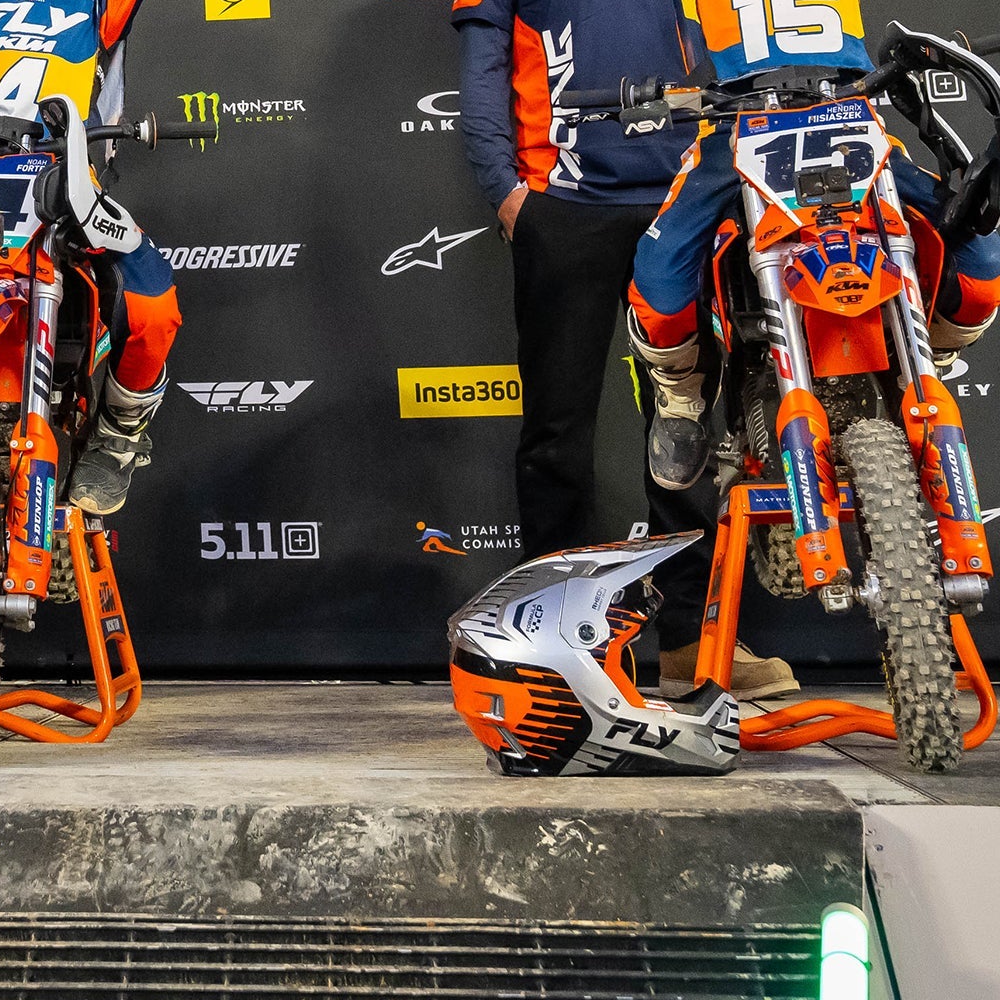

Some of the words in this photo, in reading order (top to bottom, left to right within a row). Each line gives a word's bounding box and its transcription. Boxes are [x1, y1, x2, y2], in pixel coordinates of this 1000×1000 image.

[222, 99, 306, 115] MONSTER
[826, 105, 862, 113] HENDRIX
[235, 114, 294, 123] ENERGY
[401, 119, 455, 133] OAK
[625, 117, 667, 135] ASV
[808, 112, 861, 124] MISIASZEK
[754, 126, 875, 193] 15
[92, 215, 128, 241] LEATT
[826, 281, 870, 295] KTM
[178, 379, 314, 404] FLY
[415, 379, 521, 403] Insta360
[207, 405, 287, 413] RACING
[949, 444, 967, 507] DUNLOP
[798, 462, 817, 531] DUNLOP
[33, 477, 44, 536] DUNLOP
[461, 525, 498, 536] UTAH
[201, 522, 278, 560] 5.11
[462, 538, 521, 549] COMMIS
[534, 604, 544, 619] CP
[605, 718, 681, 749] FLY
